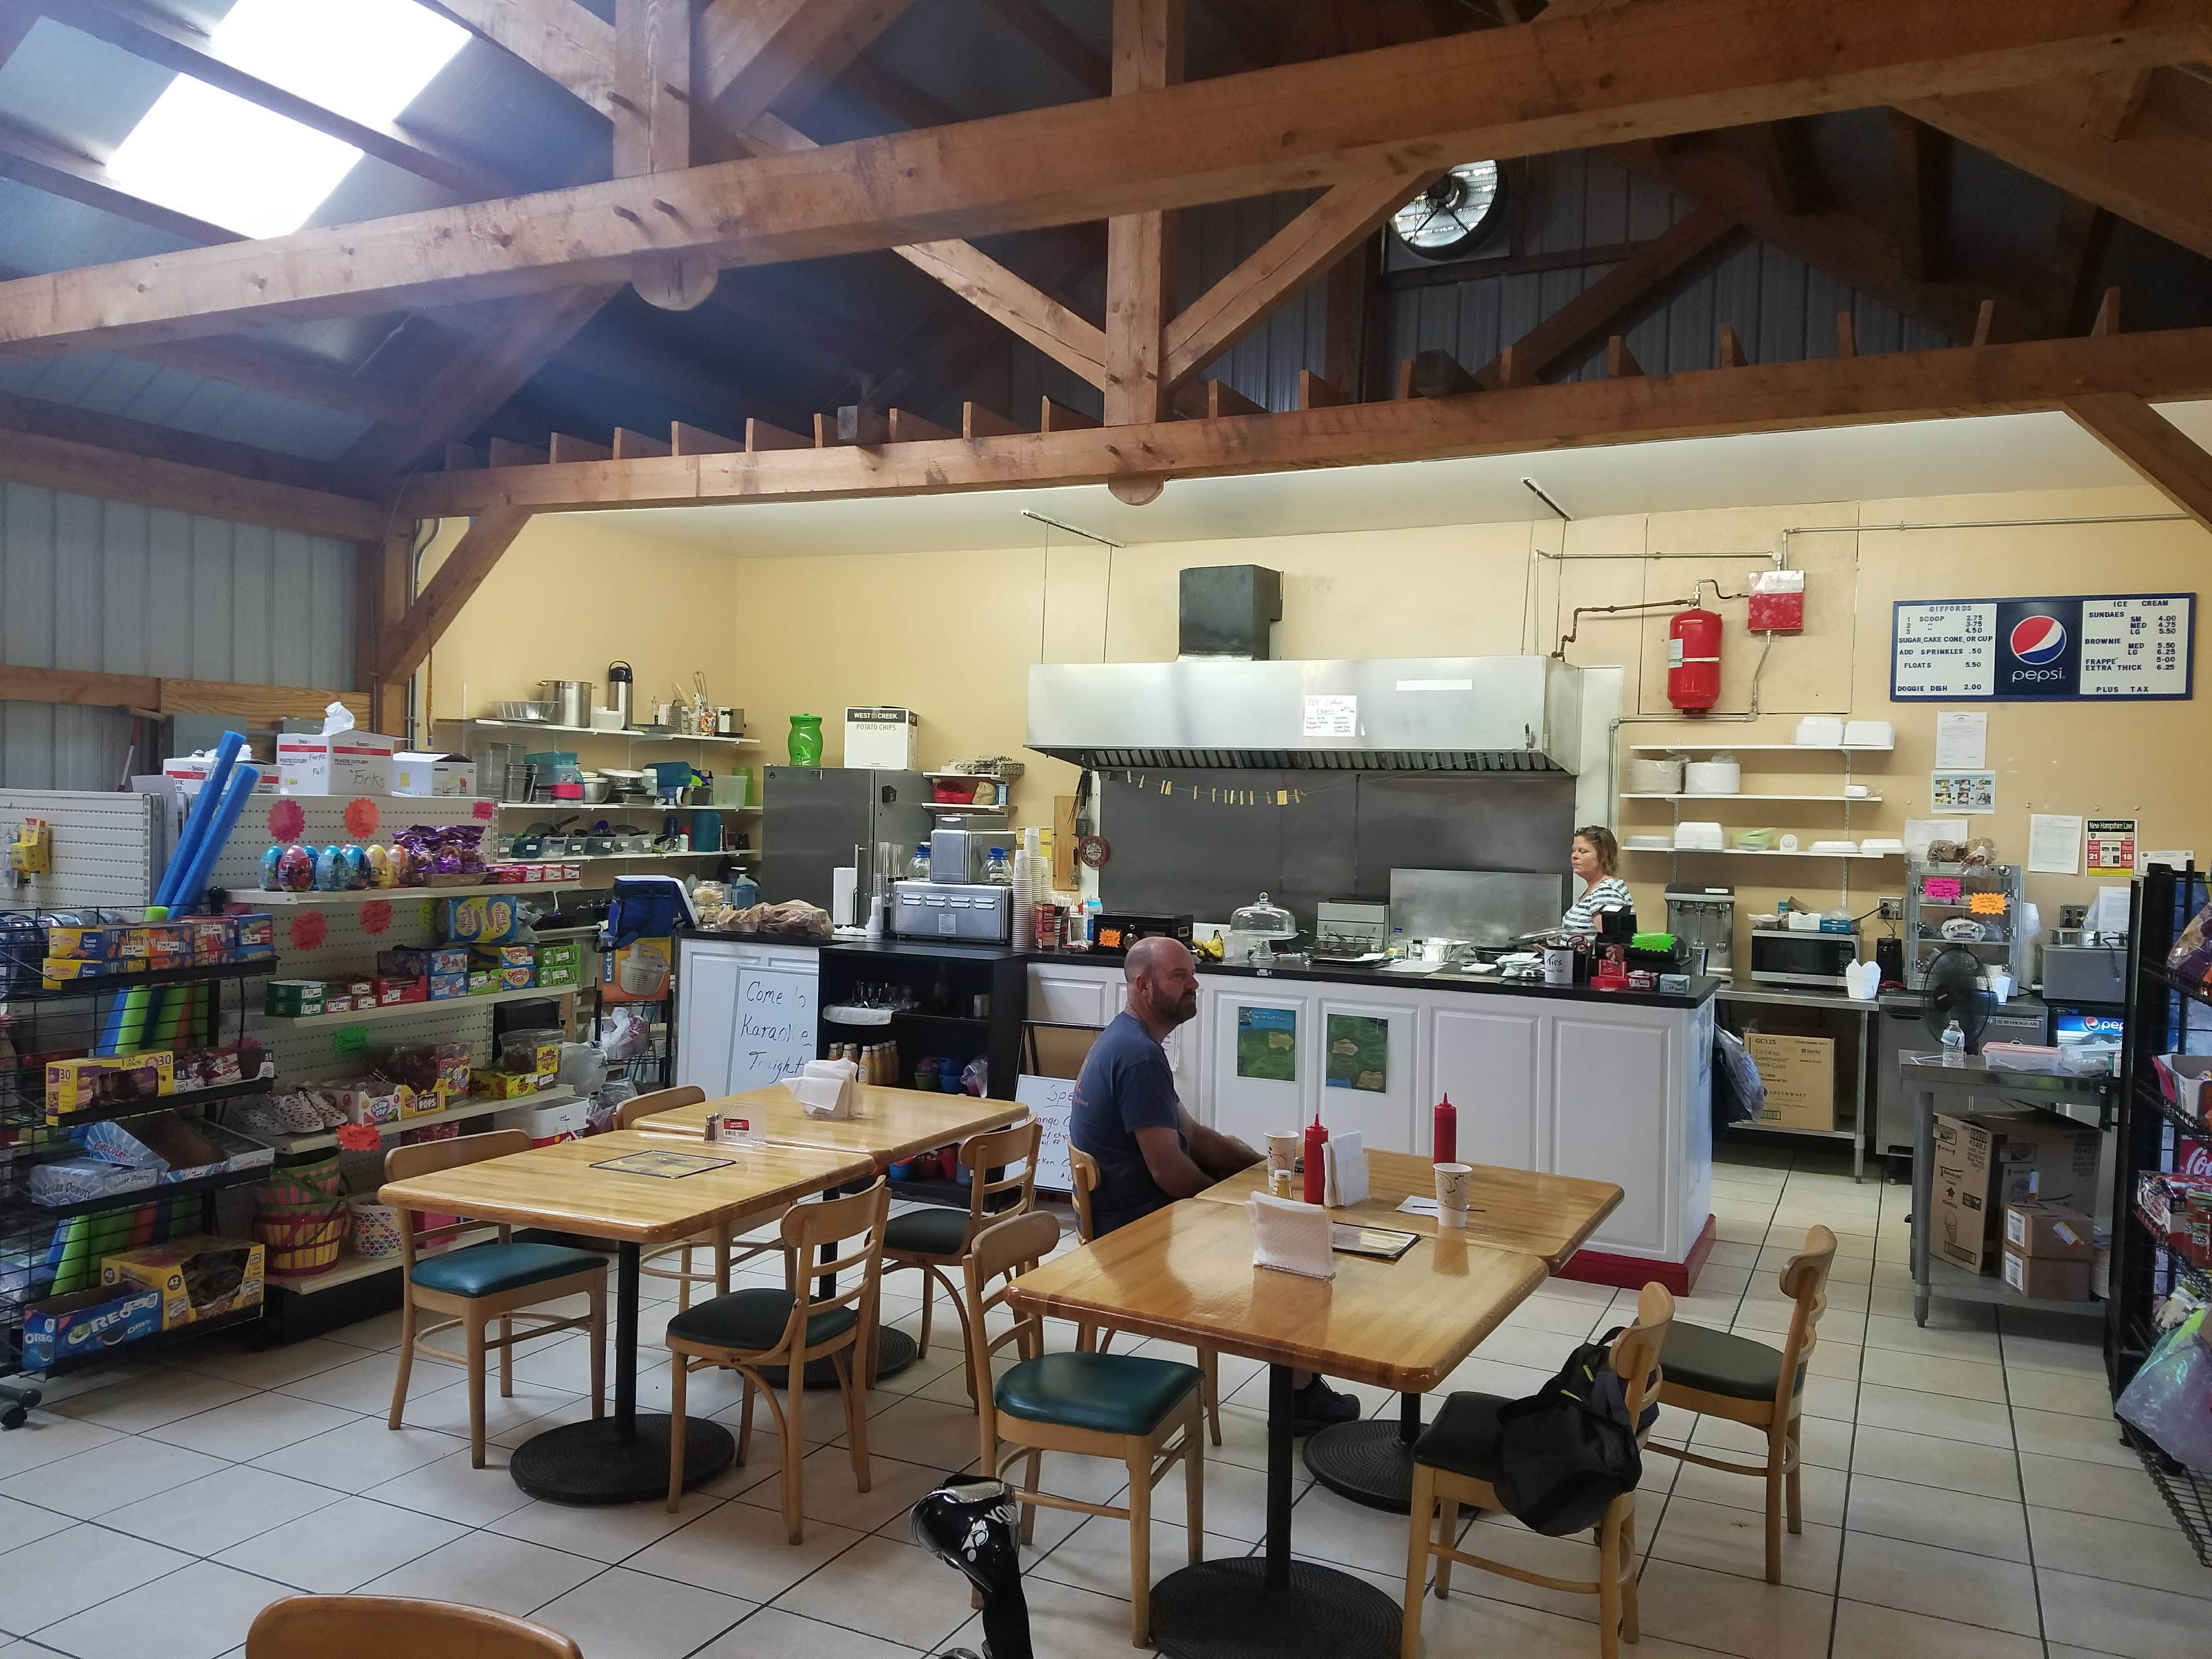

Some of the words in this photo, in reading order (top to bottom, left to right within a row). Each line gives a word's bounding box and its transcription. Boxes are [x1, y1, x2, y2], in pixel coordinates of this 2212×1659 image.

[2012, 667, 2062, 682] pepsi
[2100, 822, 2123, 831] Hampshire
[464, 904, 473, 933] Swedish
[495, 904, 503, 933] Swedish
[506, 947, 527, 957] Swedish
[507, 968, 528, 980] Swedish
[512, 975, 524, 984] Fish
[747, 980, 783, 1005] Come
[158, 1054, 171, 1066] 30
[60, 1069, 71, 1080] 30
[419, 1098, 436, 1109] POPS
[1053, 1131, 1070, 1141] chip
[43, 1184, 63, 1196] SUGAR
[65, 1182, 92, 1200] DONUTS
[168, 1277, 179, 1286] 42
[67, 1308, 132, 1344] OREO
[127, 1319, 151, 1334] OREO
[25, 1333, 53, 1344] OREO
